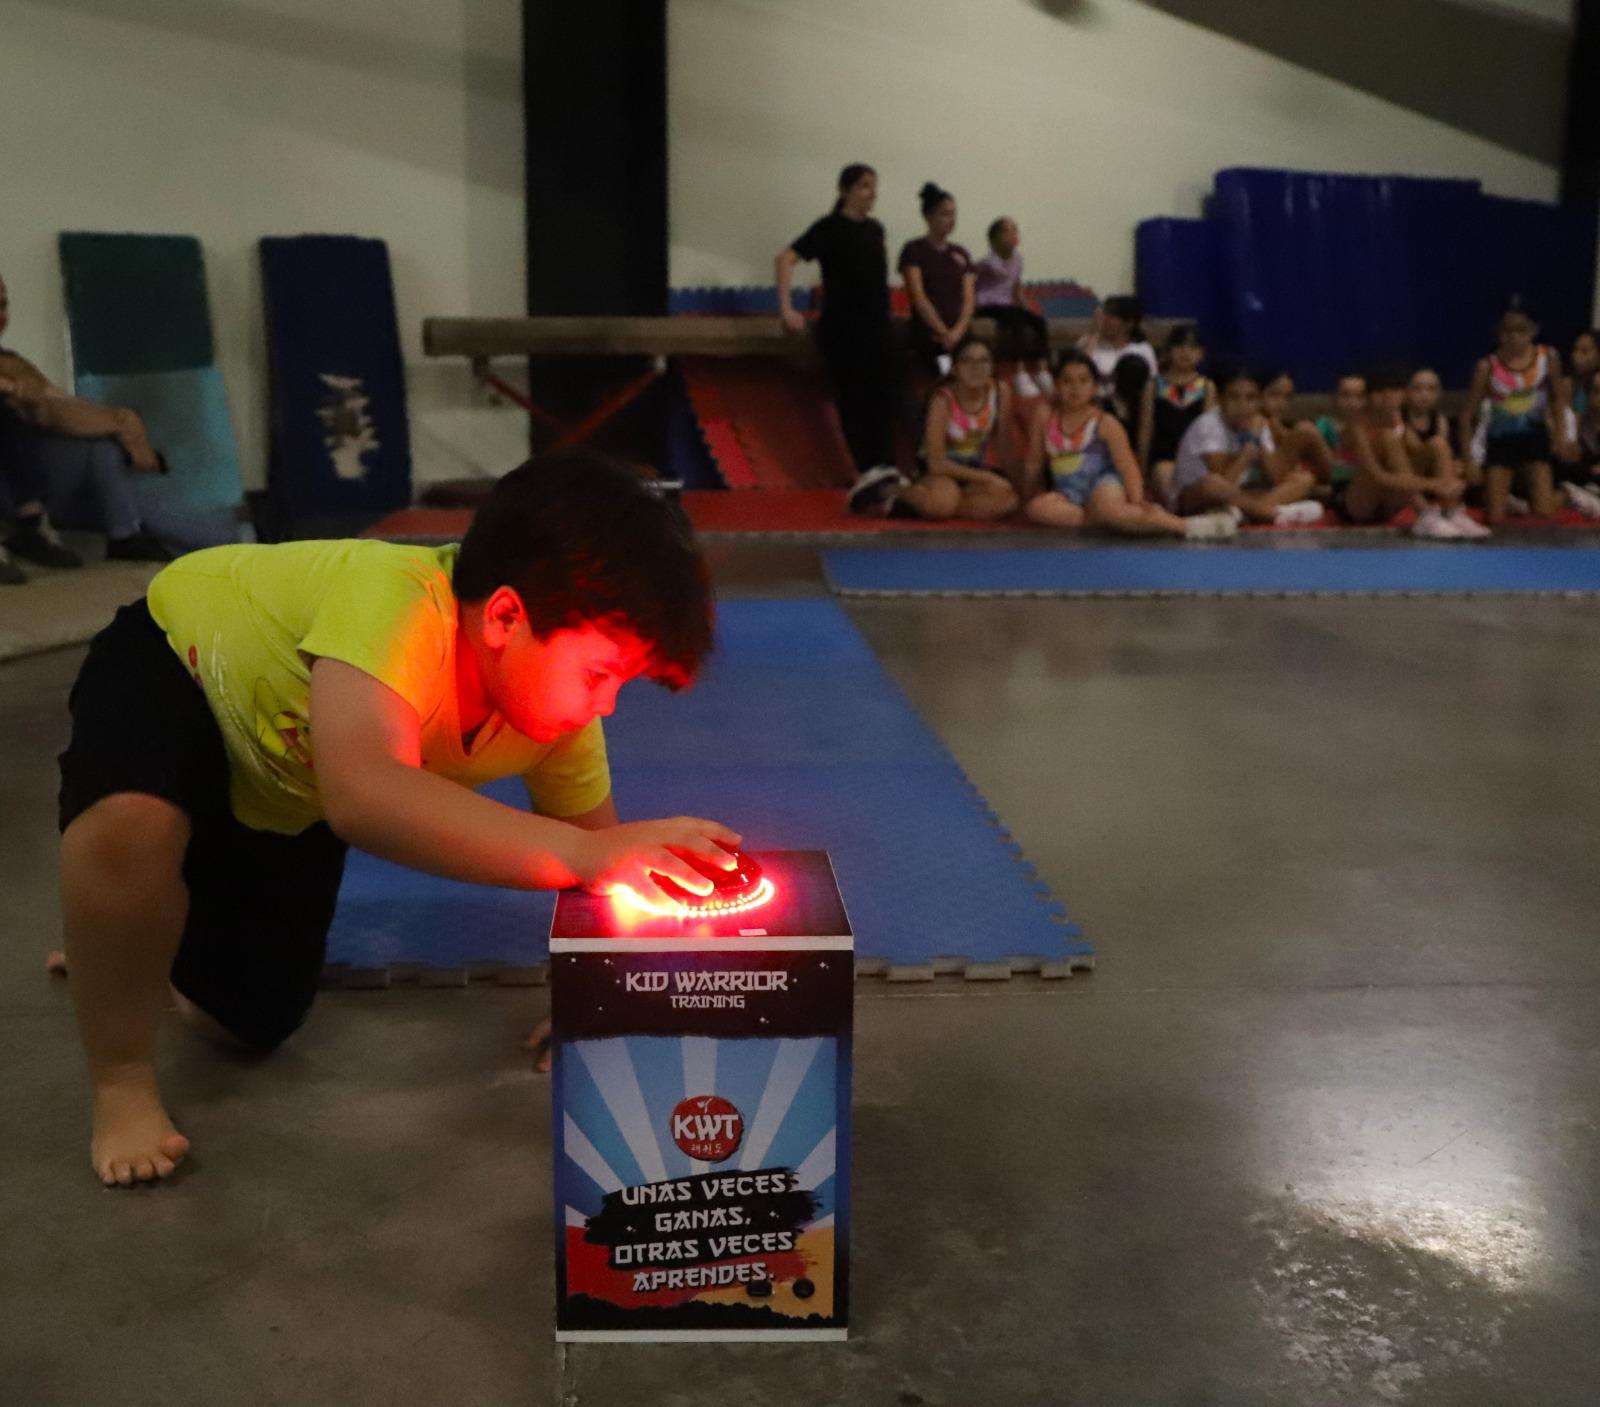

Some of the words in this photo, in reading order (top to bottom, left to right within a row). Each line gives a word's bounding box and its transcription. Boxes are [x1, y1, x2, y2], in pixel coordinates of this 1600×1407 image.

[626, 972, 668, 991] KID
[675, 970, 788, 992] WARRIOR
[670, 995, 745, 1008] TRAINING
[674, 1114, 739, 1140] KWT
[622, 1181, 692, 1205] UNAS
[701, 1174, 785, 1200] VECES
[615, 1240, 698, 1264] OTRAS
[708, 1232, 792, 1257] VECES
[633, 1263, 774, 1292] APRENDES.
